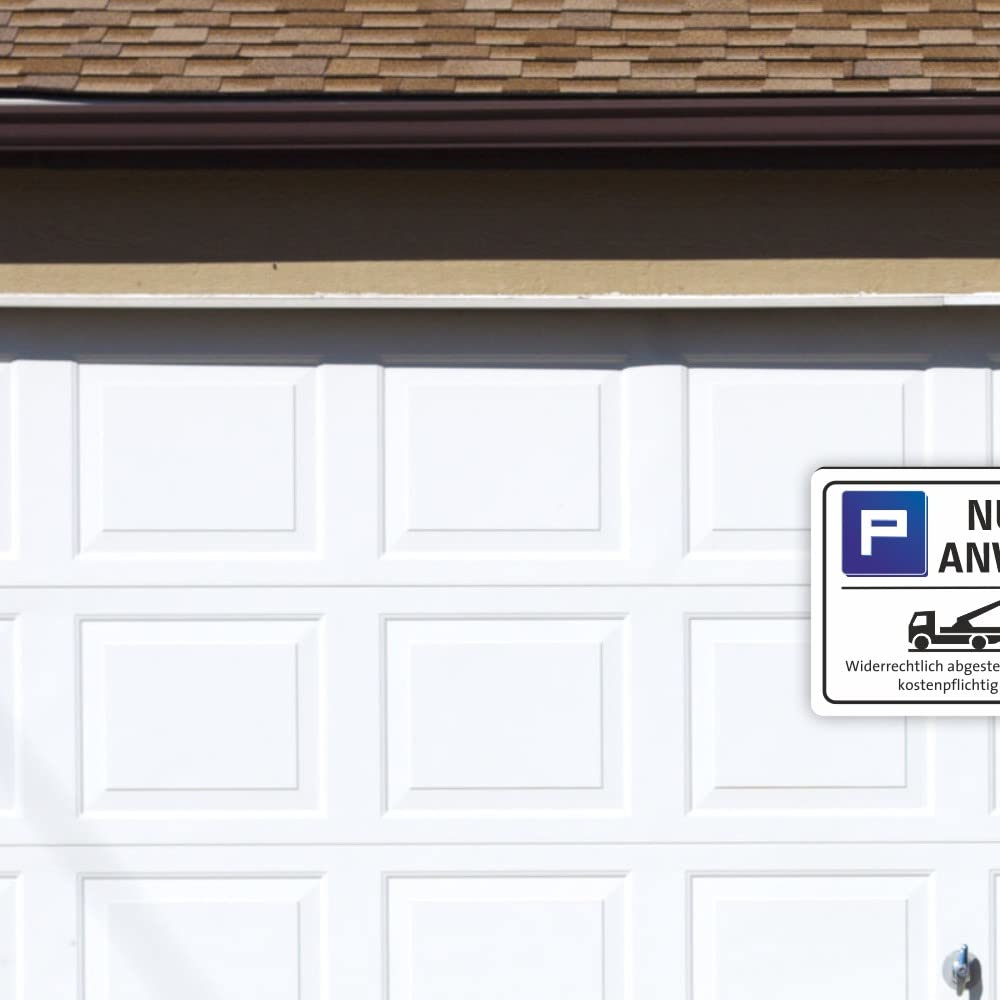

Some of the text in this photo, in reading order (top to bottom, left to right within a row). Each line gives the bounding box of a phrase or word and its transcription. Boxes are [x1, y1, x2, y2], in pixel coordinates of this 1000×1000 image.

[860, 509, 908, 556] P
[845, 659, 944, 672] Widerrechtlich
[898, 678, 999, 695] kostenpflichtig
